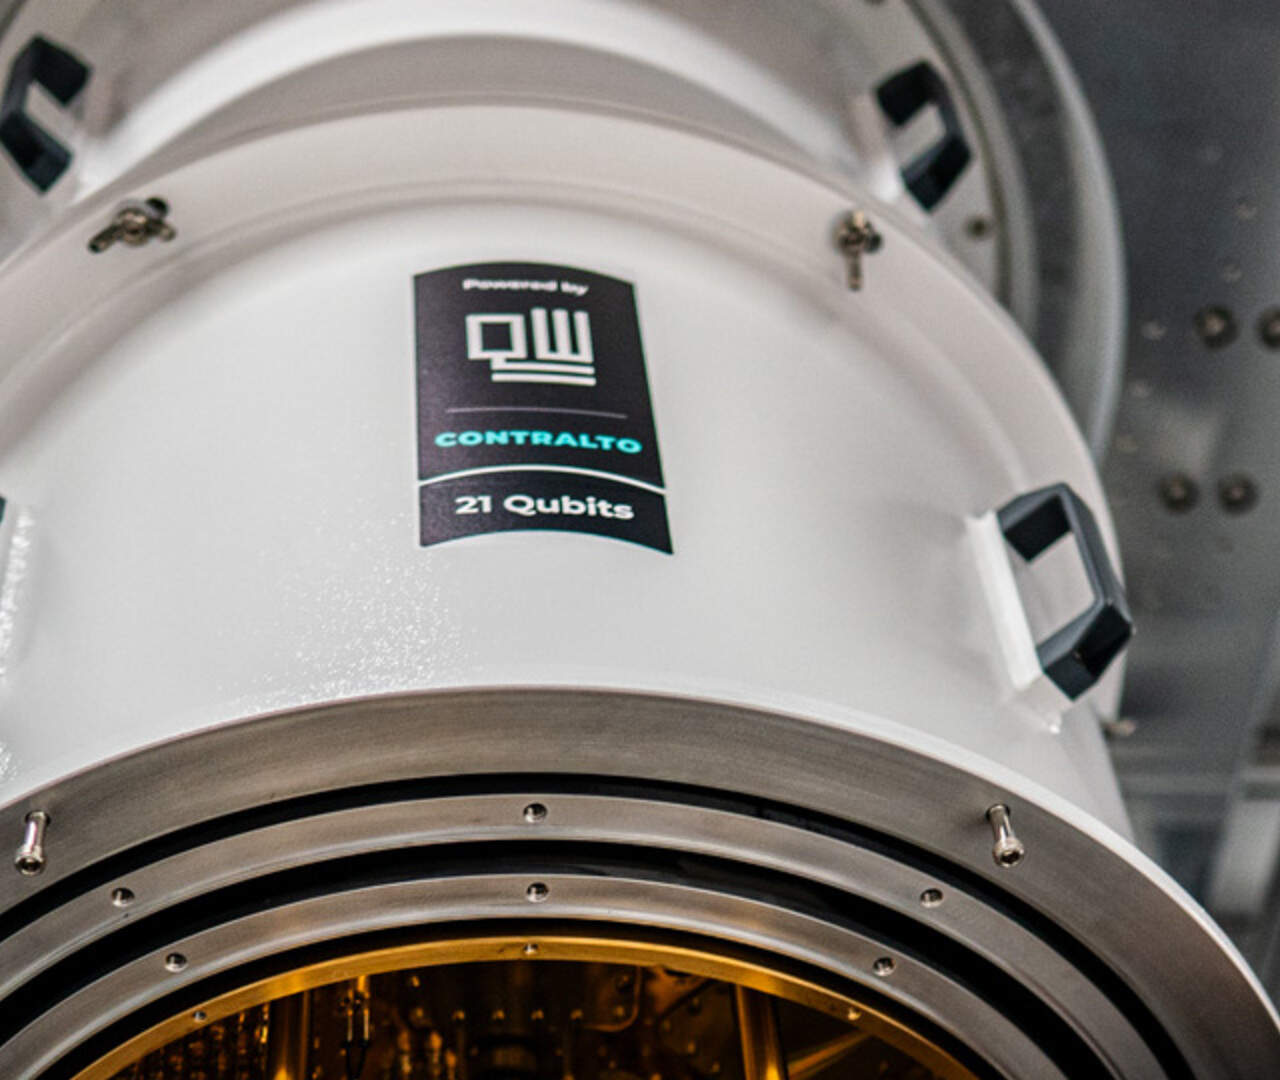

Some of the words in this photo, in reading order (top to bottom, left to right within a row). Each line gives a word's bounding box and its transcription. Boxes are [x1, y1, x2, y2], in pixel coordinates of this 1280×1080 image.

[461, 277, 558, 292] Powered
[560, 281, 589, 296] by
[433, 429, 643, 454] CONTRALTO
[454, 494, 492, 515] 21
[503, 494, 635, 520] Qubits
